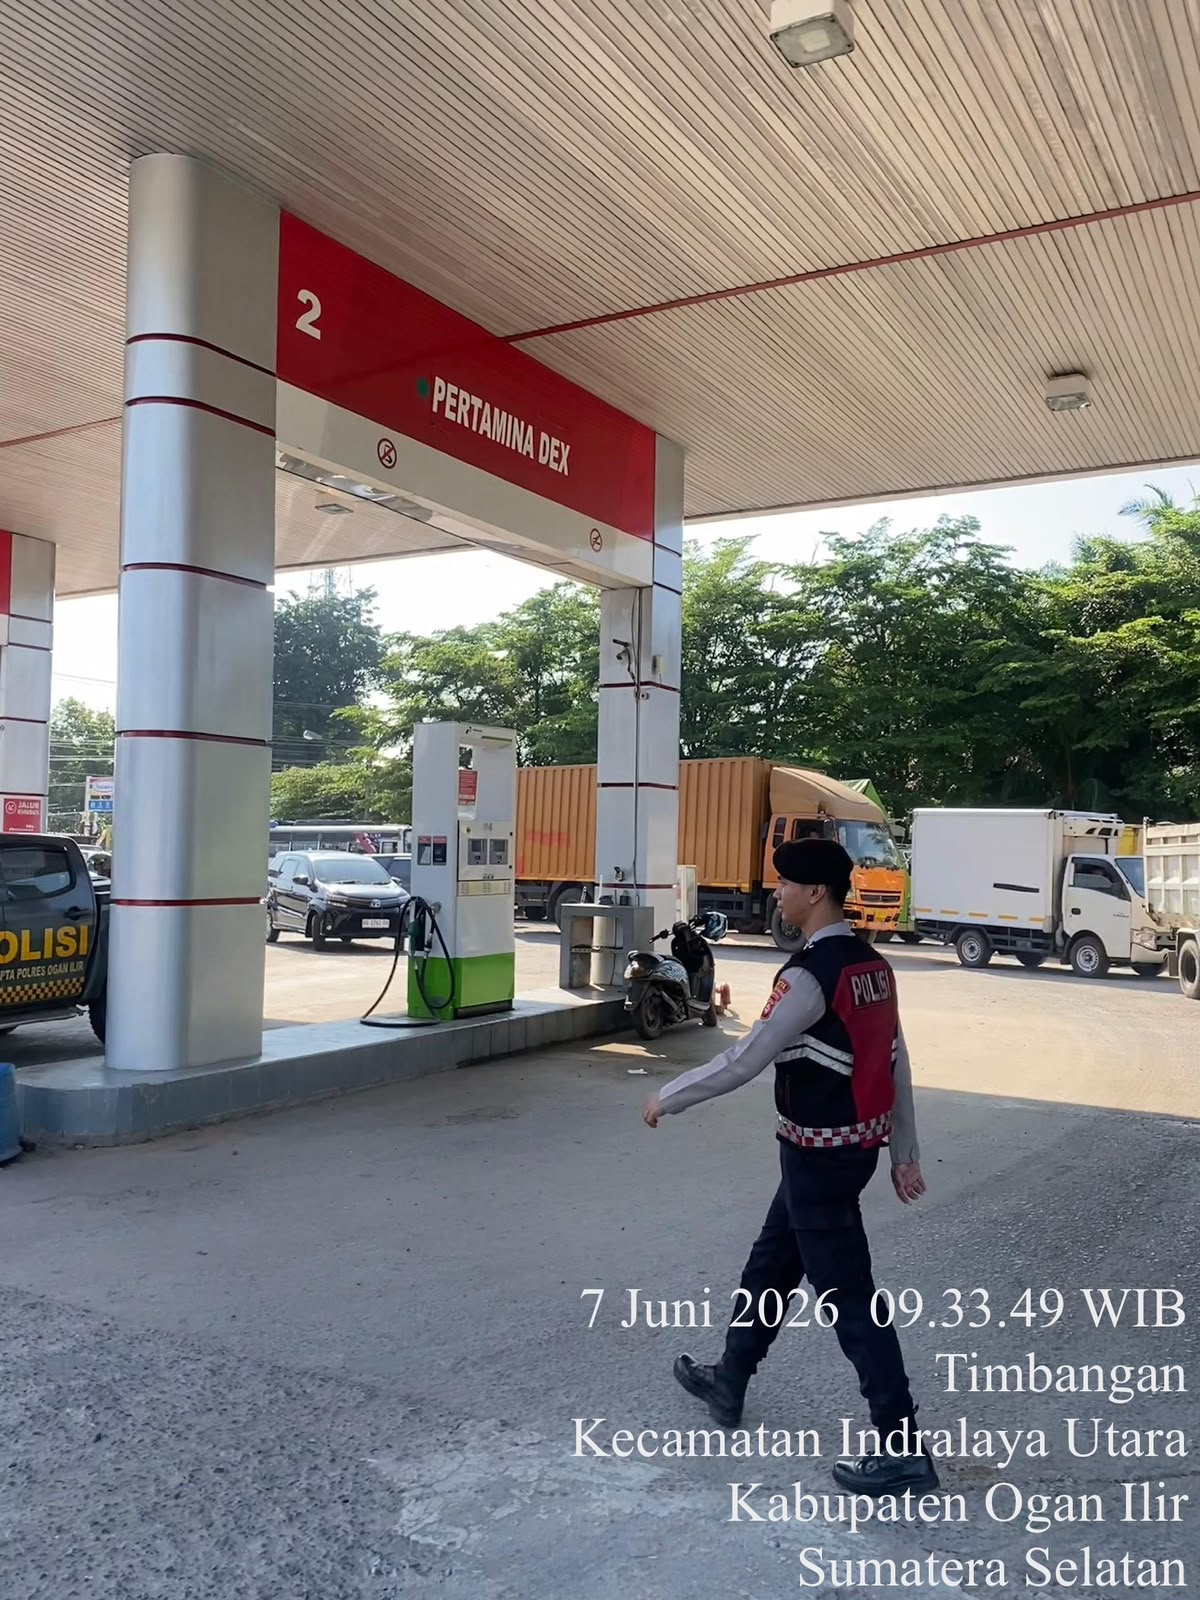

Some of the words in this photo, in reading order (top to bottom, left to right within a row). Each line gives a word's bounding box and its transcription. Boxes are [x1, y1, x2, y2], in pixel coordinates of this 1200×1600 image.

[295, 289, 322, 340] 2
[432, 376, 534, 459] PERTAMINA
[538, 432, 571, 476] DEX
[18, 801, 39, 809] JALUR
[16, 966, 46, 979] POLRES
[47, 962, 69, 976] OGAN
[70, 960, 84, 972] ILIR
[851, 969, 891, 1006] POLISI
